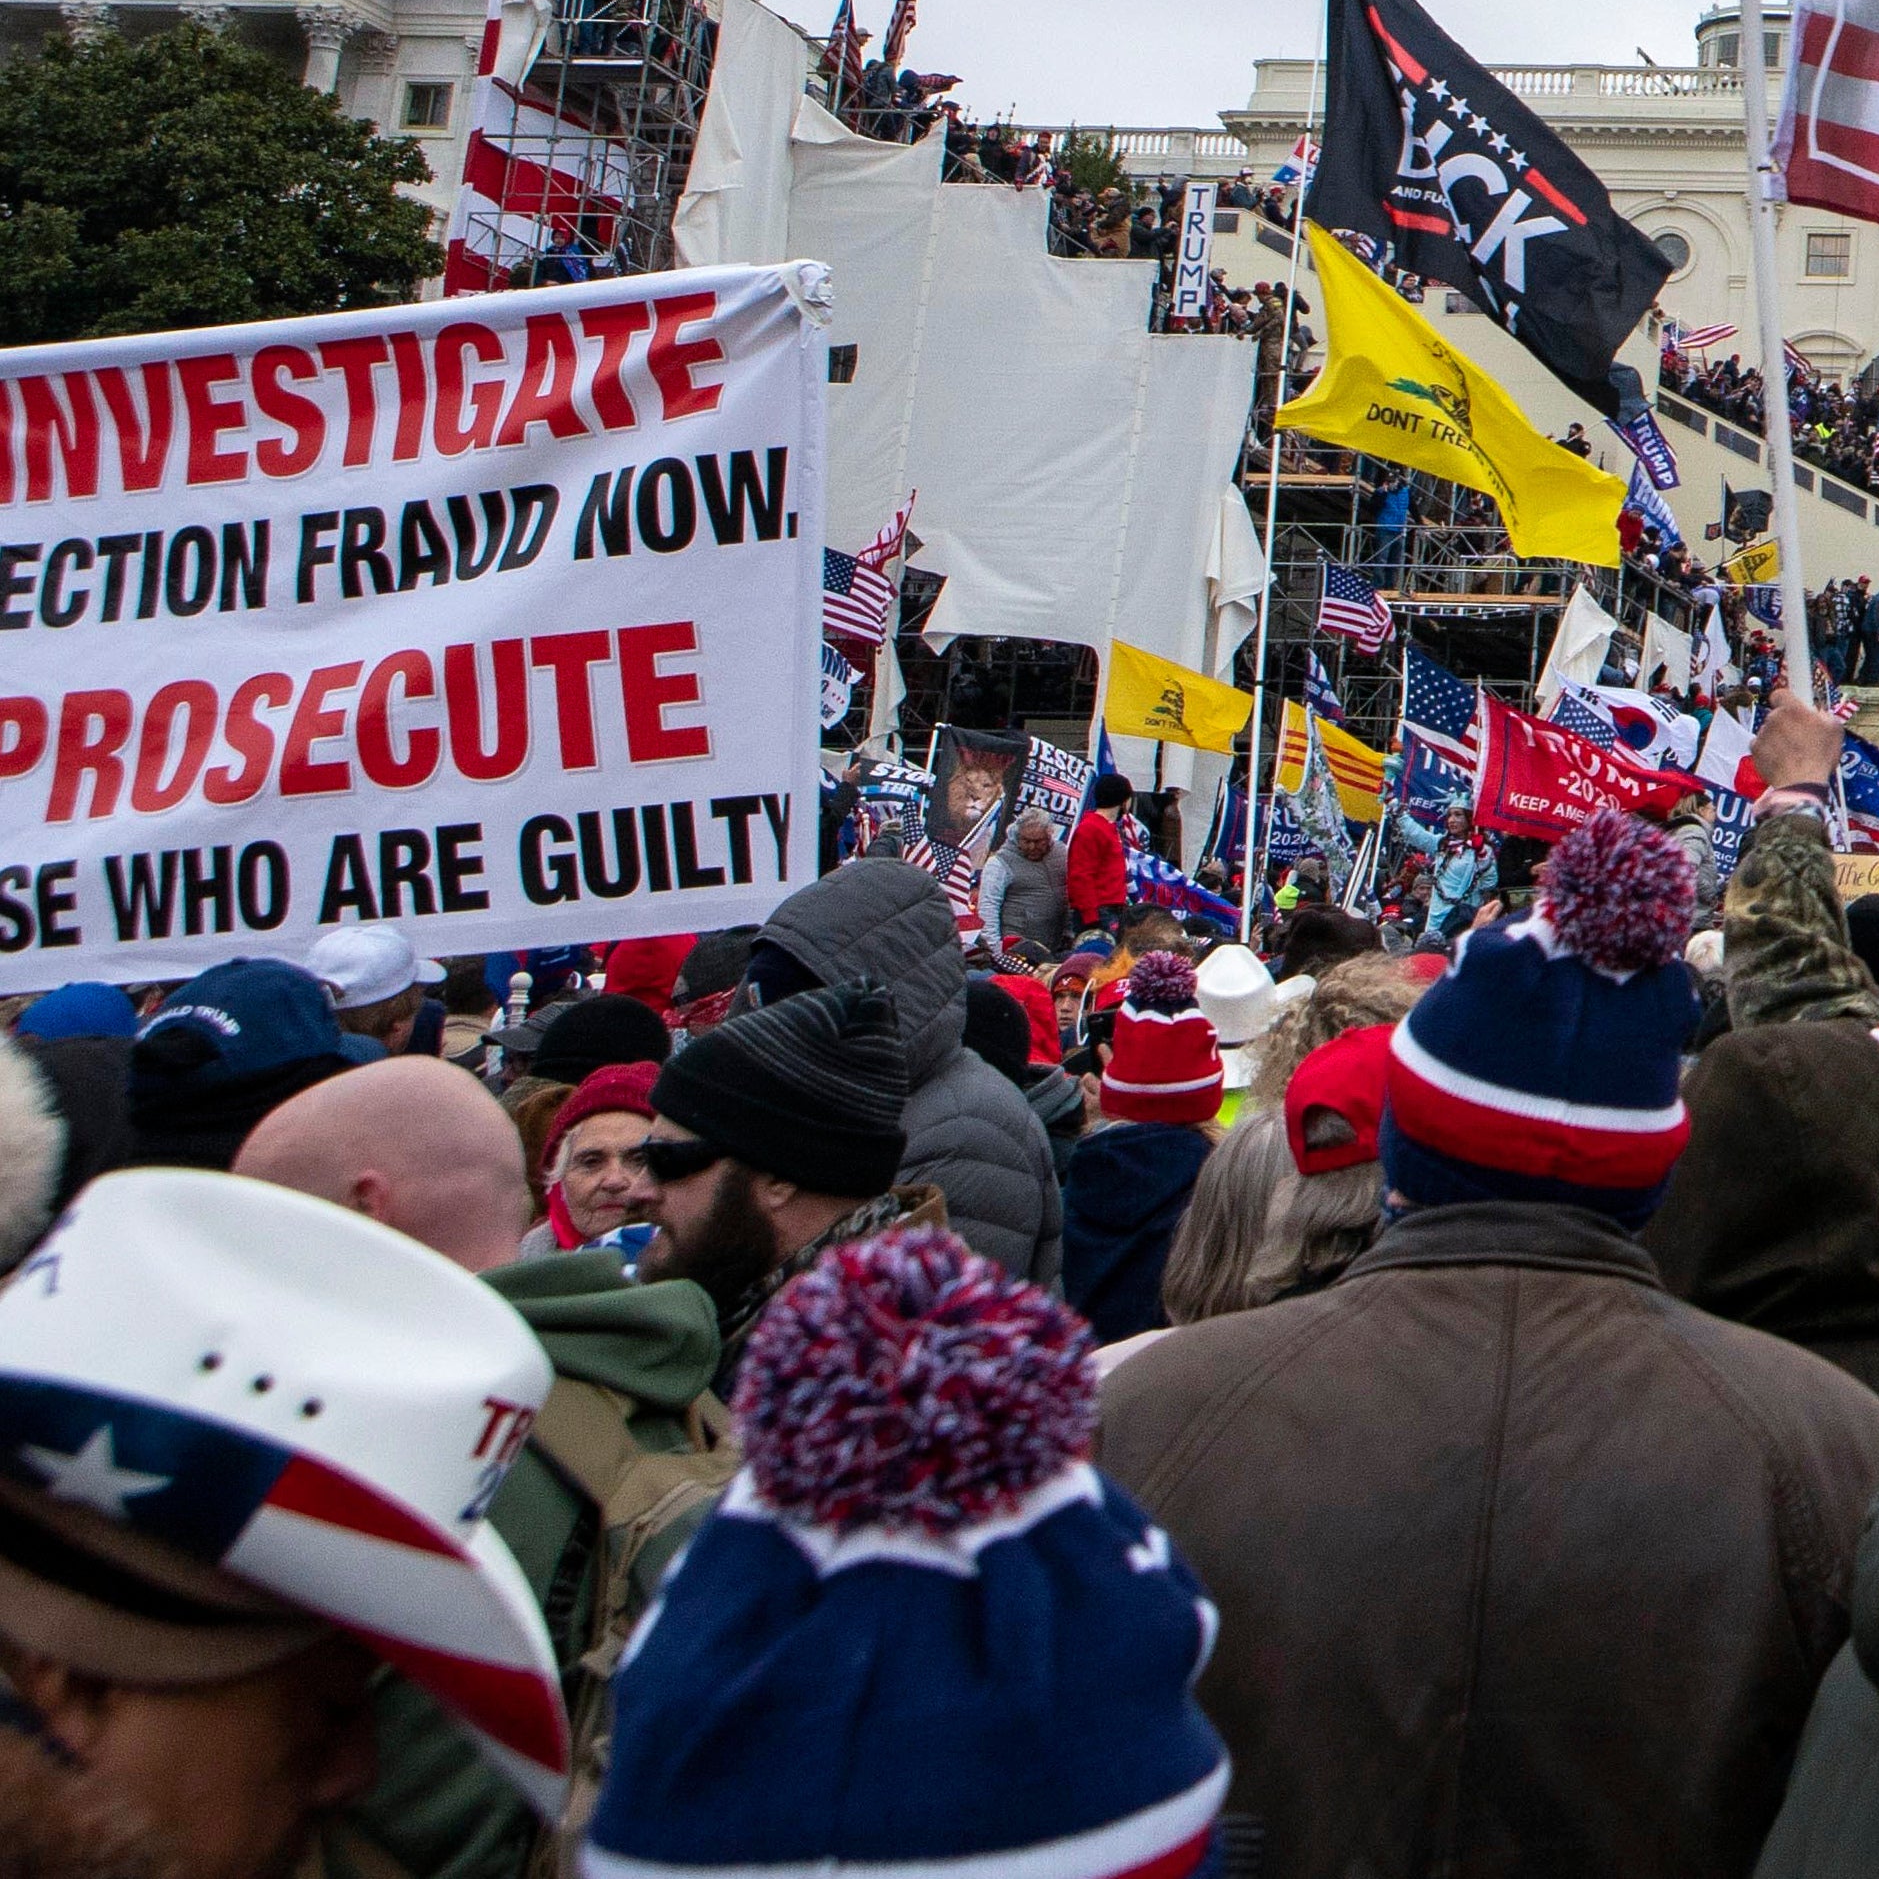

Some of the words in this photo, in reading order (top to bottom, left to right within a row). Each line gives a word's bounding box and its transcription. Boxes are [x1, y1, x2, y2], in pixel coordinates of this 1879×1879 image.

[1391, 184, 1423, 201] AND
[1178, 187, 1211, 314] TRUMP
[1366, 403, 1424, 434] DONT
[1634, 411, 1674, 485] TRUMP
[297, 483, 561, 604] FRAUD
[574, 446, 799, 561] NOW.
[0, 620, 711, 824] PROSECUTE
[1028, 735, 1099, 784] JESUS
[1038, 763, 1057, 778] MY
[880, 781, 917, 799] THE
[1509, 792, 1550, 812] KEEP
[1271, 831, 1308, 847] 2020
[104, 840, 291, 942] WHO
[318, 822, 491, 924] ARE
[518, 792, 792, 907] GUILTY
[1837, 862, 1865, 886] The
[196, 1005, 241, 1036] TRUMP
